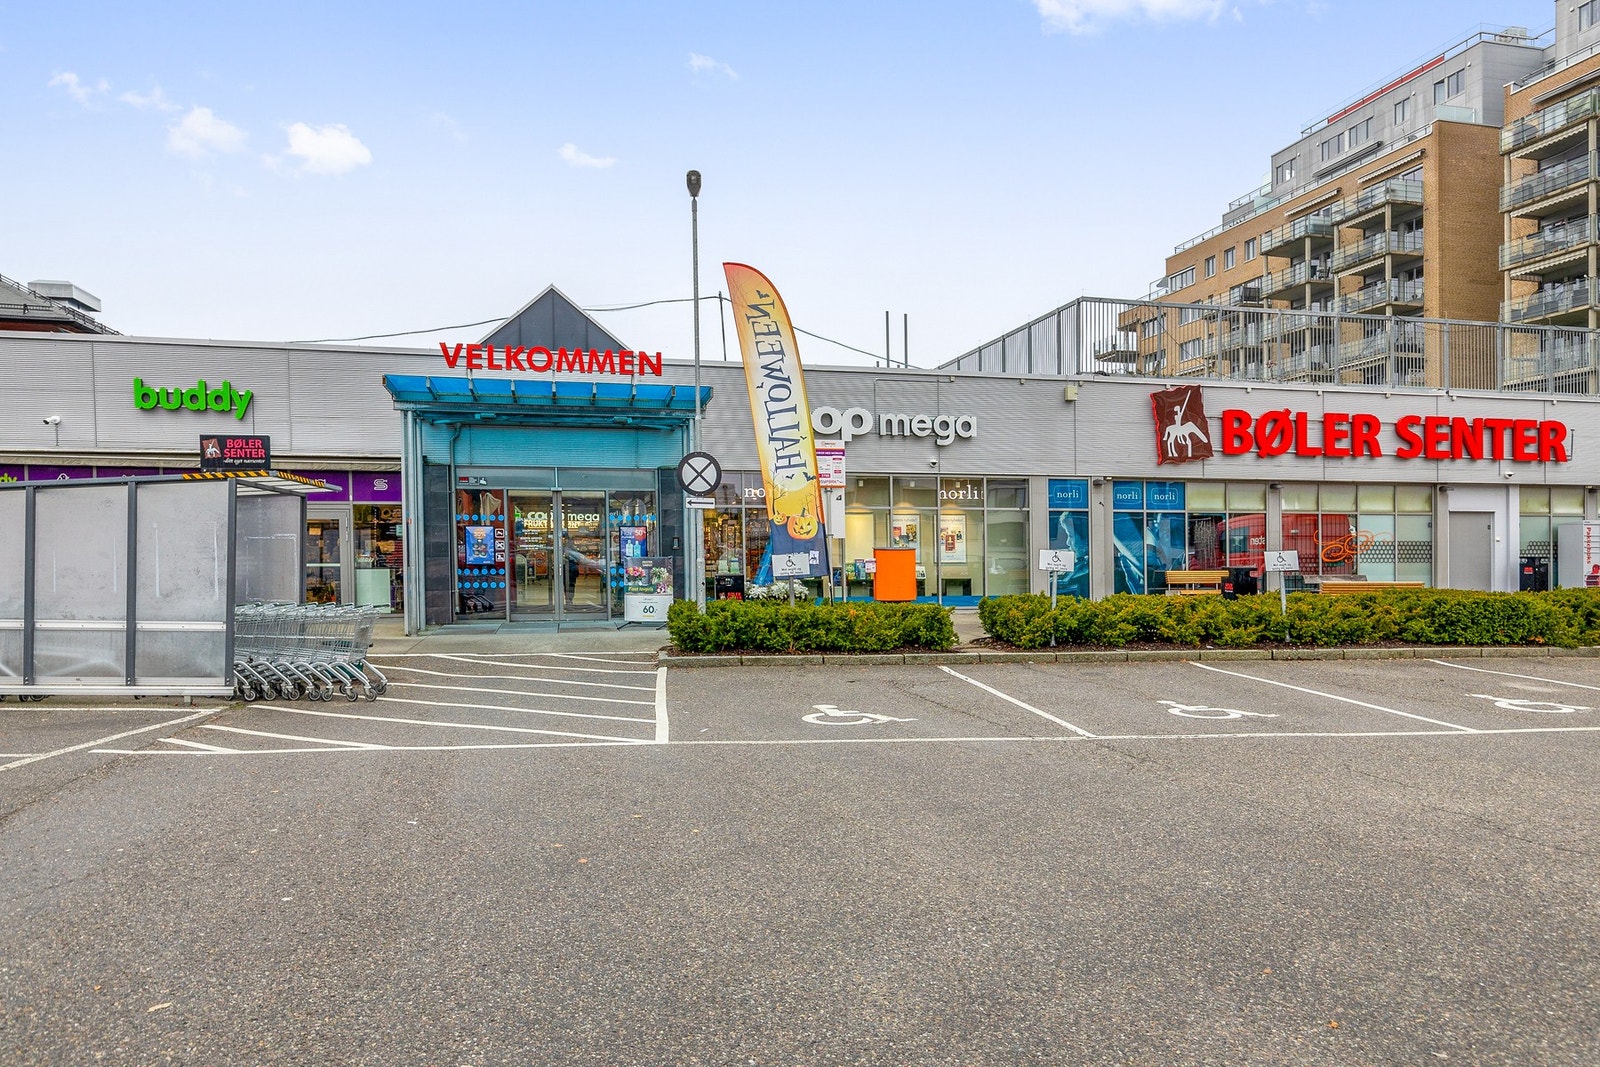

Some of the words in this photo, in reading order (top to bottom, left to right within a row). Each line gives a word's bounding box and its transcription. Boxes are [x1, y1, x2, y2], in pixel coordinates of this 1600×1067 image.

[439, 342, 663, 376] VELKOMMEN
[133, 377, 253, 420] buddy
[811, 405, 874, 442] op
[879, 412, 978, 447] mega
[1222, 408, 1383, 458] BØLER
[1396, 415, 1568, 463] SENTER
[226, 438, 262, 448] BØLER
[223, 448, 266, 458] SENTER
[939, 484, 979, 500] norli
[1056, 489, 1079, 499] norli
[1116, 491, 1138, 500] norli
[1153, 491, 1175, 501] norli
[567, 513, 600, 523] mega
